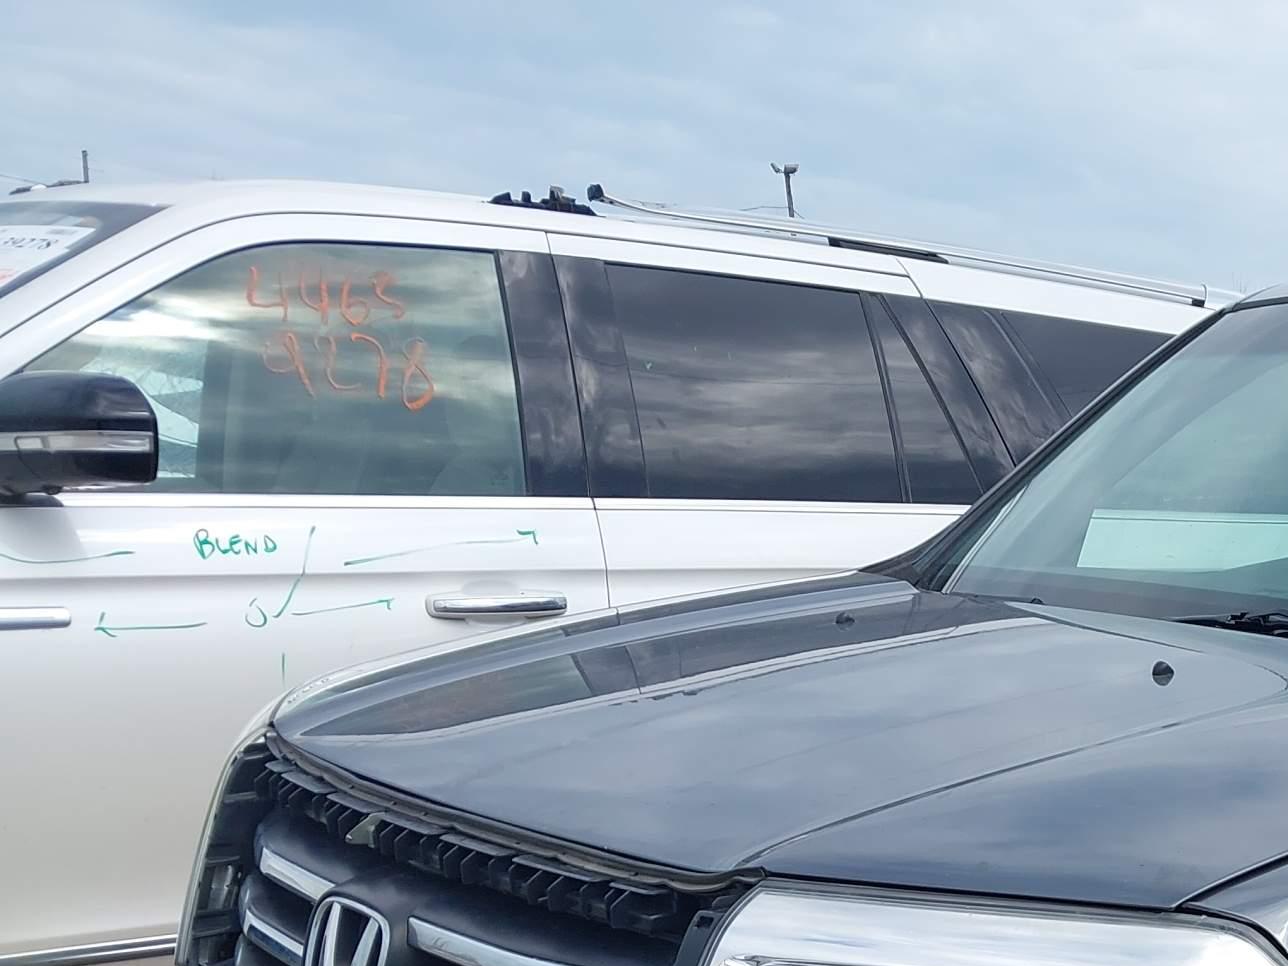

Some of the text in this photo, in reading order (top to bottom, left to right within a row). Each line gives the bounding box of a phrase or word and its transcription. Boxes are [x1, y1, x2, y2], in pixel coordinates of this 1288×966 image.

[246, 266, 405, 326] 4465
[259, 332, 436, 412] 9278
[193, 528, 278, 560] BLEND
